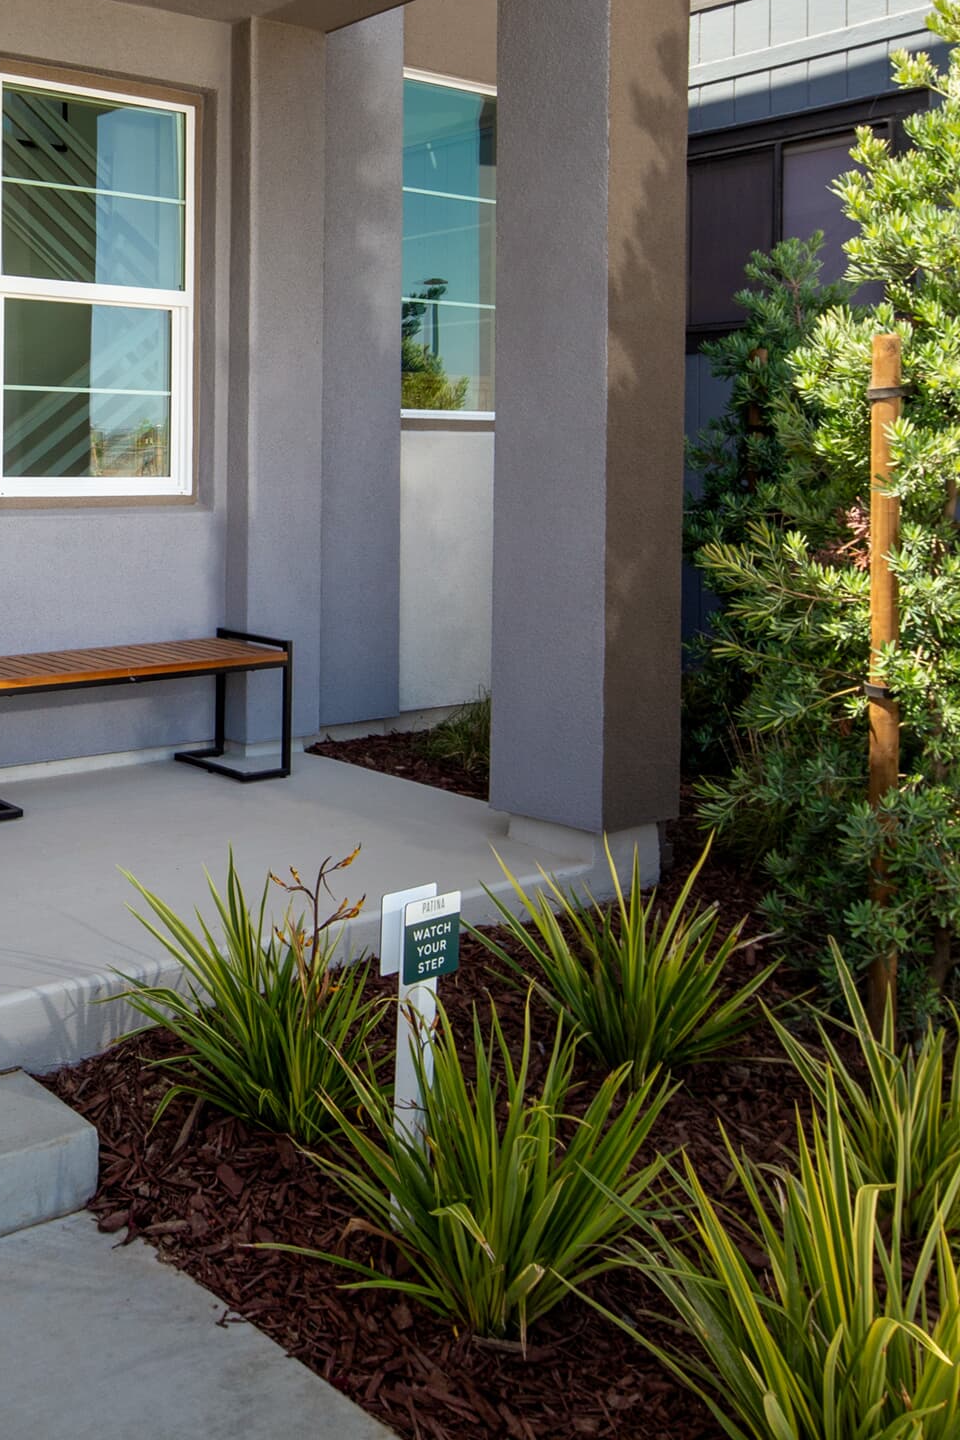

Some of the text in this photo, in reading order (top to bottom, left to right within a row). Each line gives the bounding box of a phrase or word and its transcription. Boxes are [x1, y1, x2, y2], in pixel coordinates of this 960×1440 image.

[422, 898, 445, 913] PATINA
[413, 921, 451, 941] WATCH
[417, 939, 447, 957] YOUR
[418, 957, 445, 974] STEP
